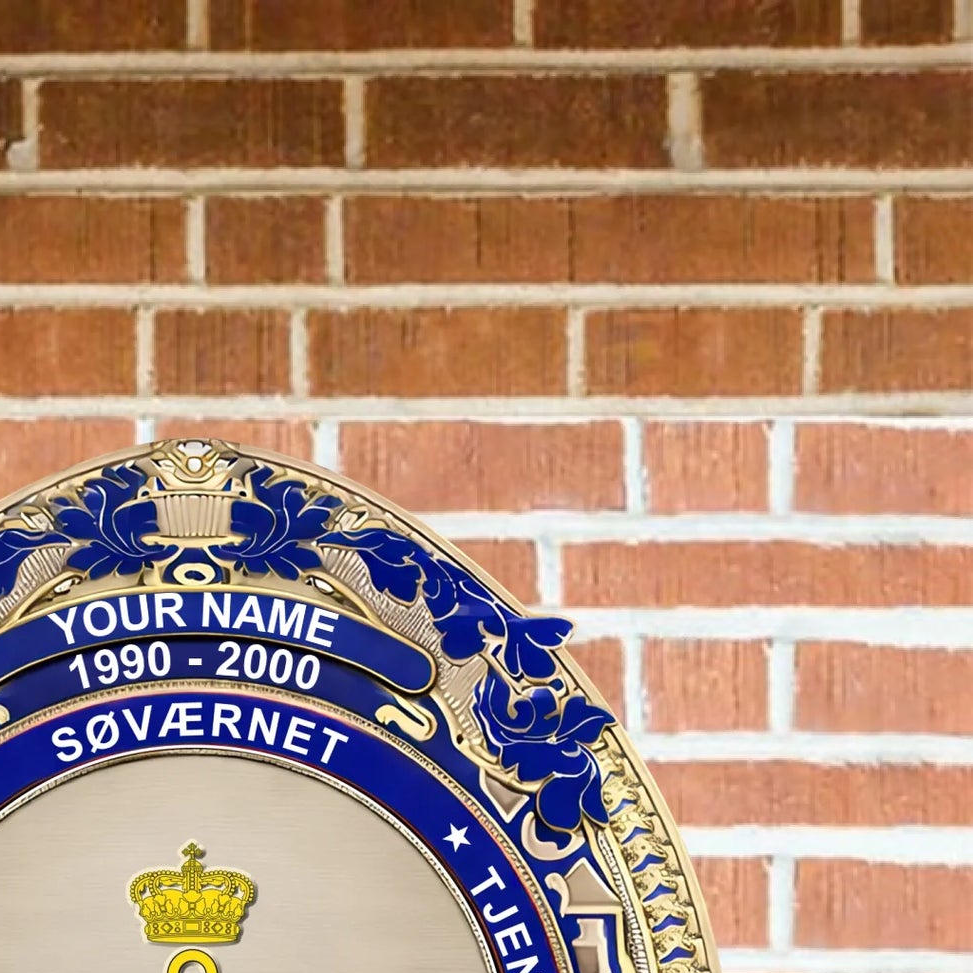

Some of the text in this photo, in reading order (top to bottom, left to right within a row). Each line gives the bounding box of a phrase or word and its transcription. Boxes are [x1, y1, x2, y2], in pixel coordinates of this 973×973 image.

[46, 591, 340, 648] YOUR NAME
[68, 640, 171, 689] 1990
[215, 640, 321, 690] 2000
[51, 701, 349, 764] SØVÆRNET
